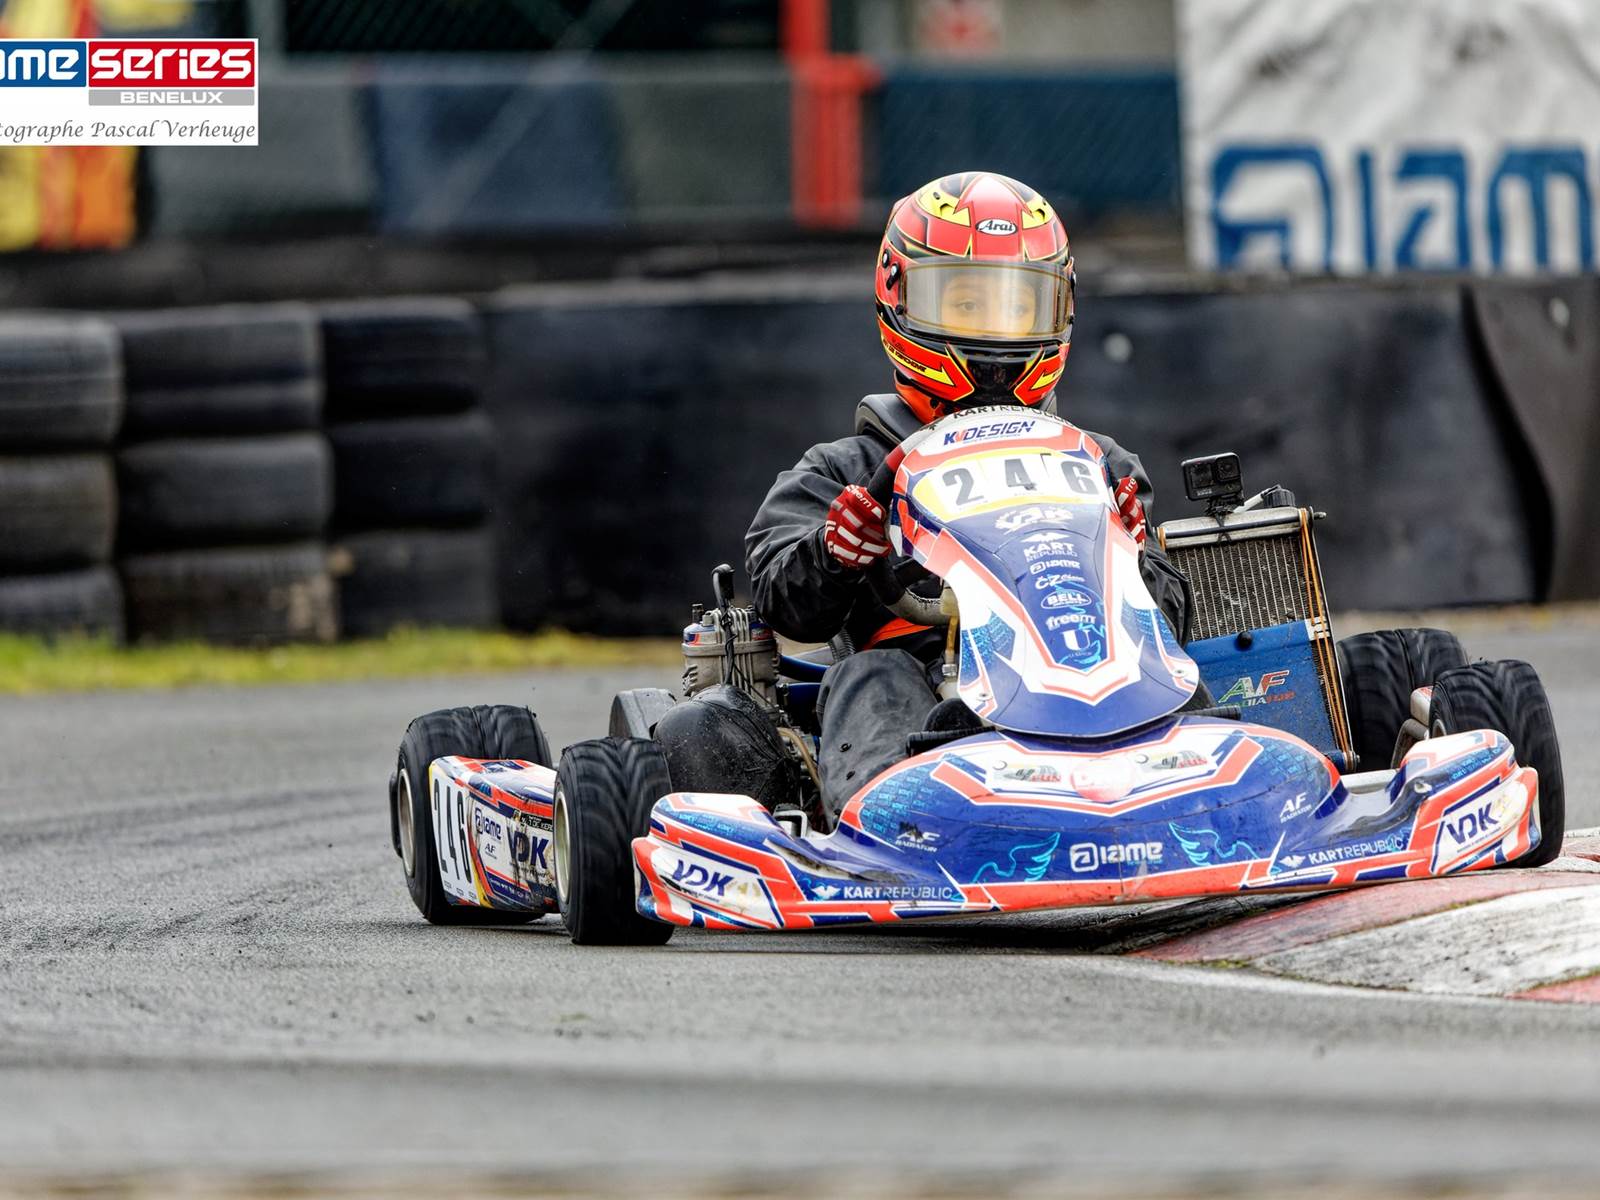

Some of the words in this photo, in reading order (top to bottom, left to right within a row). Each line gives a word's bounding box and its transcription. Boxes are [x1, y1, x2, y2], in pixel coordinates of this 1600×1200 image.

[978, 218, 1013, 232] Arai
[1023, 542, 1075, 558] KART
[1047, 592, 1087, 606] BELL
[1046, 613, 1097, 631] freem
[1218, 669, 1290, 704] AF
[1279, 792, 1307, 818] AF
[433, 778, 473, 884] 246
[1447, 802, 1499, 845] VDK
[507, 823, 549, 870] VDK
[1308, 837, 1404, 865] KARTREPUBLIC
[672, 859, 735, 896] VDK
[843, 886, 953, 900] KARTREPUBLIC
